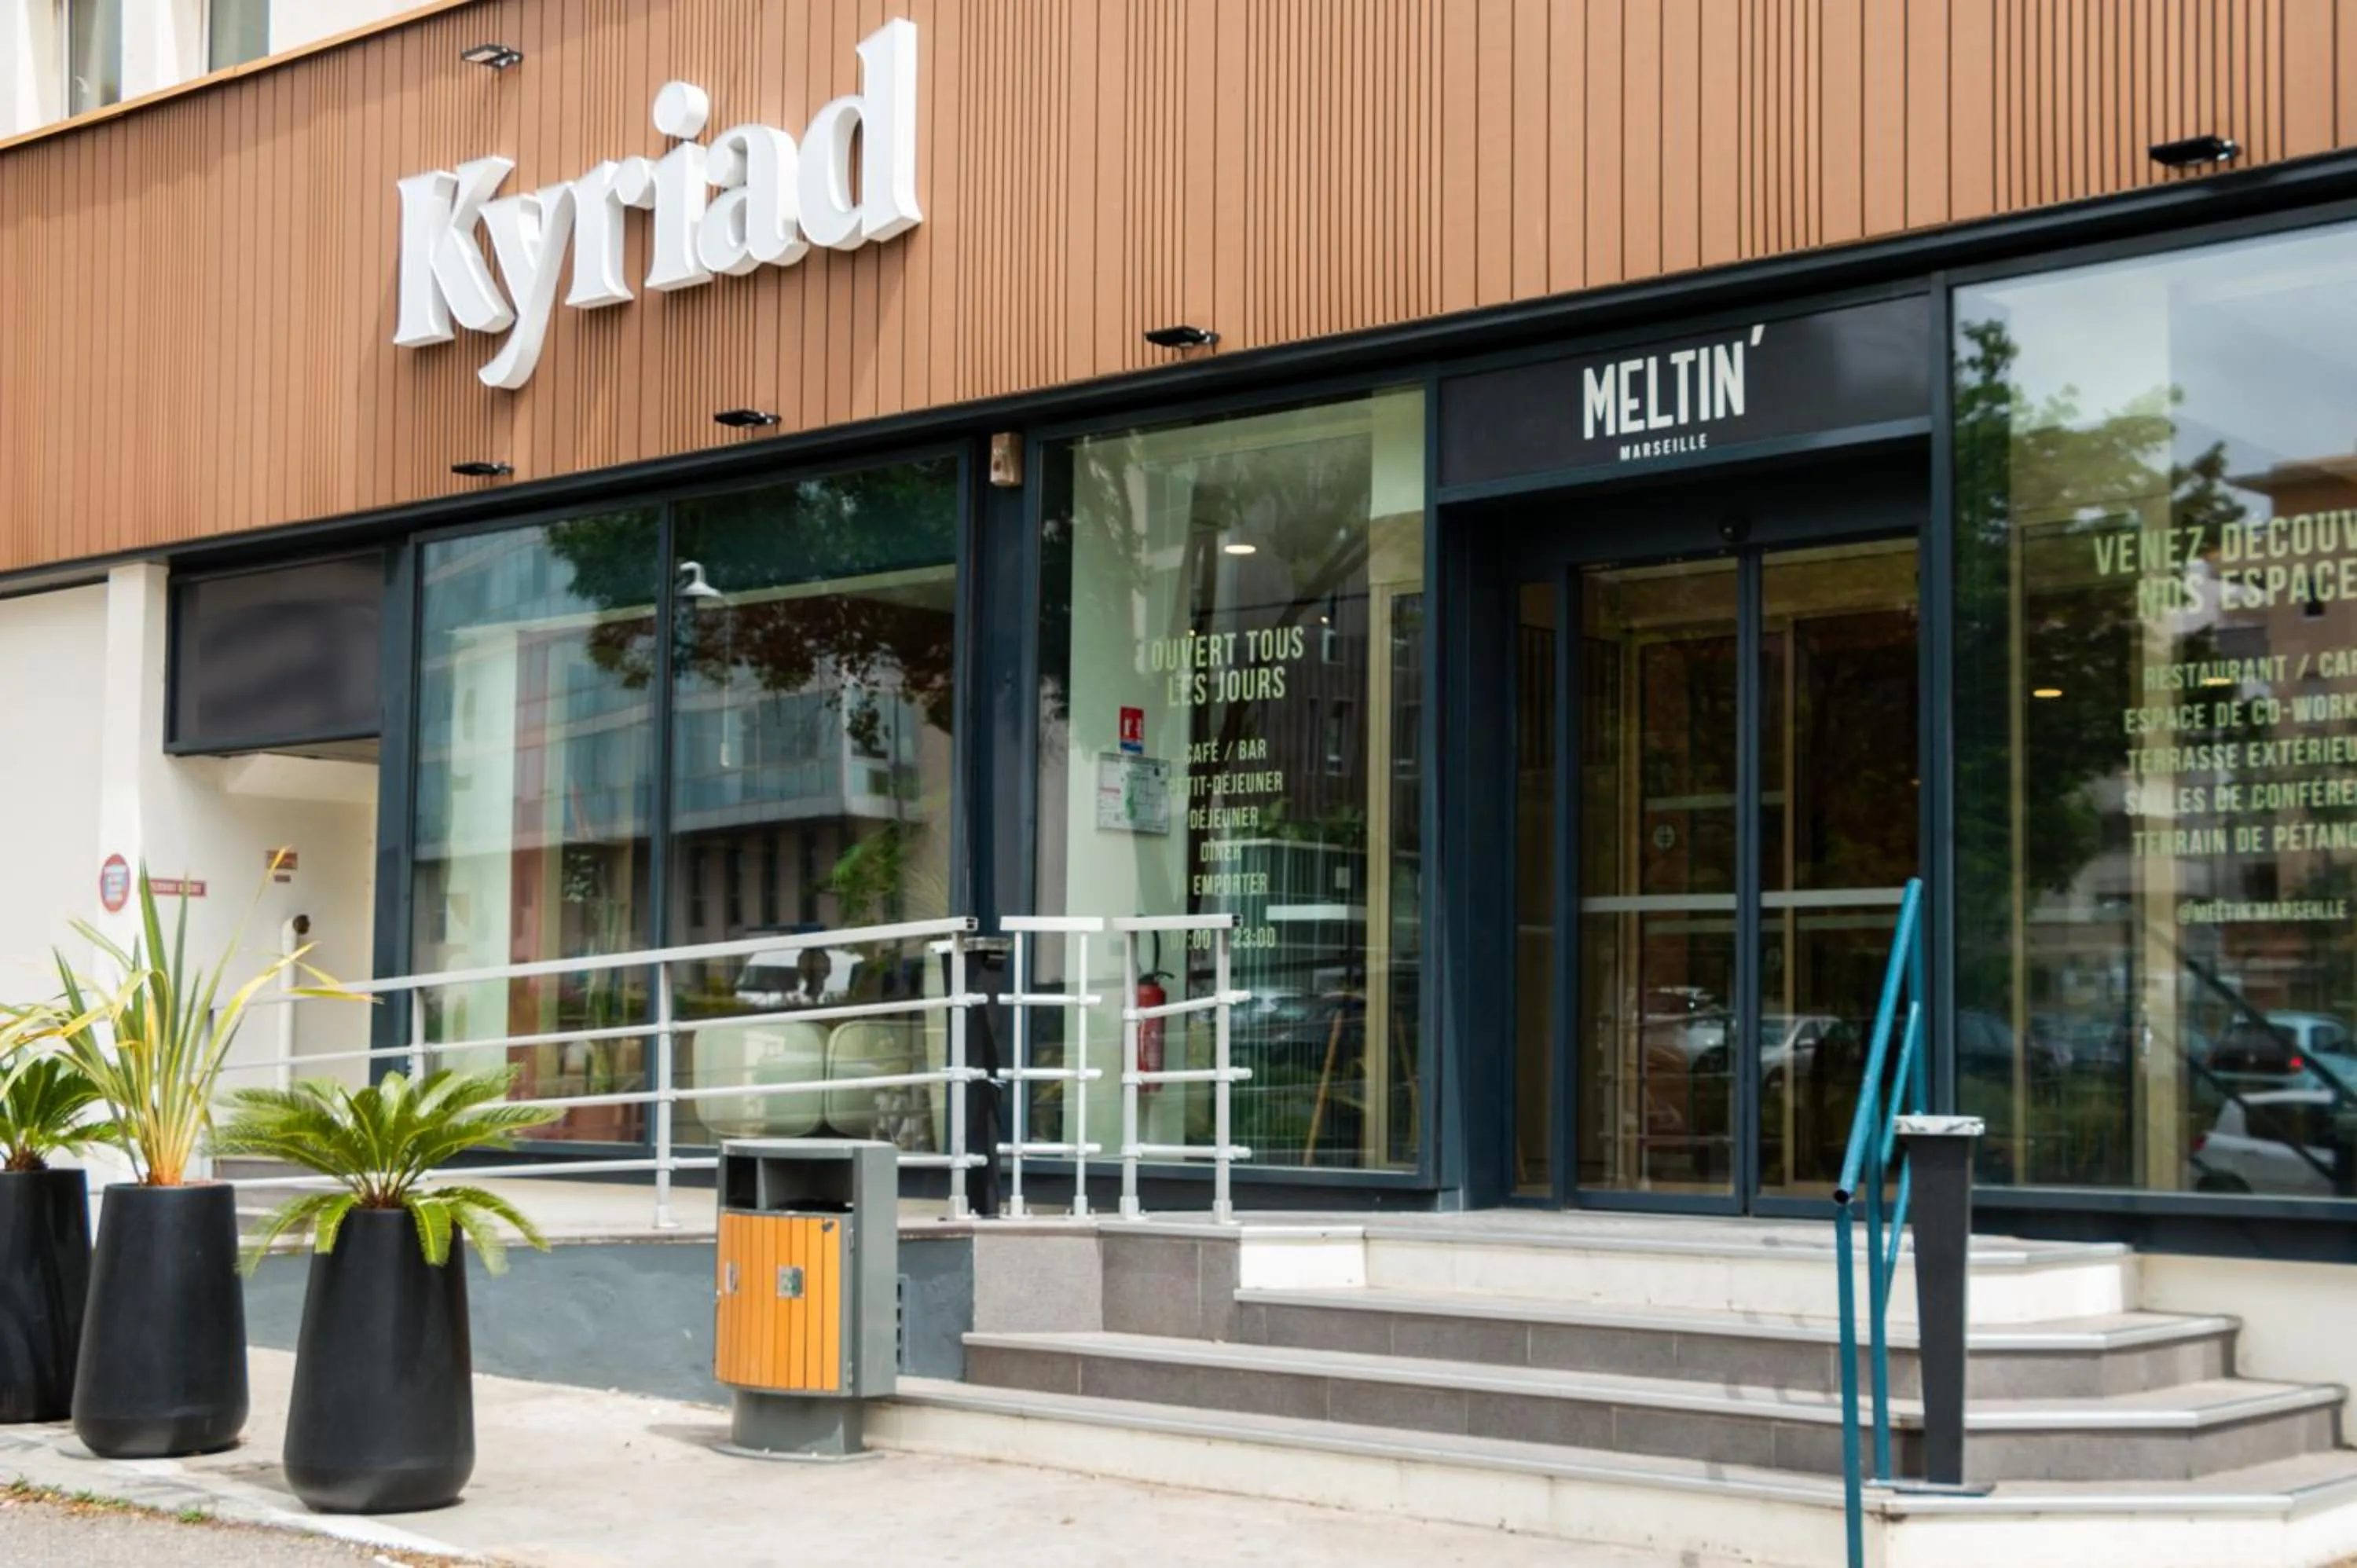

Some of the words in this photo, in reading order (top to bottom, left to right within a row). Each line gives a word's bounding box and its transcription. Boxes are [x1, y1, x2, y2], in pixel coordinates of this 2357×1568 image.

[393, 17, 922, 390] Kyriad
[1583, 324, 1765, 440] MELTIN'
[1620, 433, 1707, 460] MARSEILLE
[2095, 526, 2205, 575] VENEZ
[2137, 573, 2205, 617] NOS
[2221, 557, 2357, 610] ESPACE
[1151, 632, 1237, 671] OUVERT
[1246, 625, 1304, 663] TOUS
[1168, 672, 1207, 706] LES
[1216, 665, 1286, 703] JOURS
[2124, 703, 2207, 734] ESPACE
[2215, 702, 2244, 728] DE
[1185, 738, 1219, 764] CAFÉ
[1238, 738, 1267, 761] BAR
[2125, 743, 2239, 775] TERRASSE
[2215, 786, 2244, 812] DE
[2251, 776, 2357, 809] CONFÉRE
[1189, 804, 1259, 830] DÉJEUNER
[2132, 827, 2227, 857] TERRAIN
[2234, 826, 2264, 853] DE
[1193, 873, 1268, 896] EMPORTER
[1233, 926, 1276, 949] 23:00
